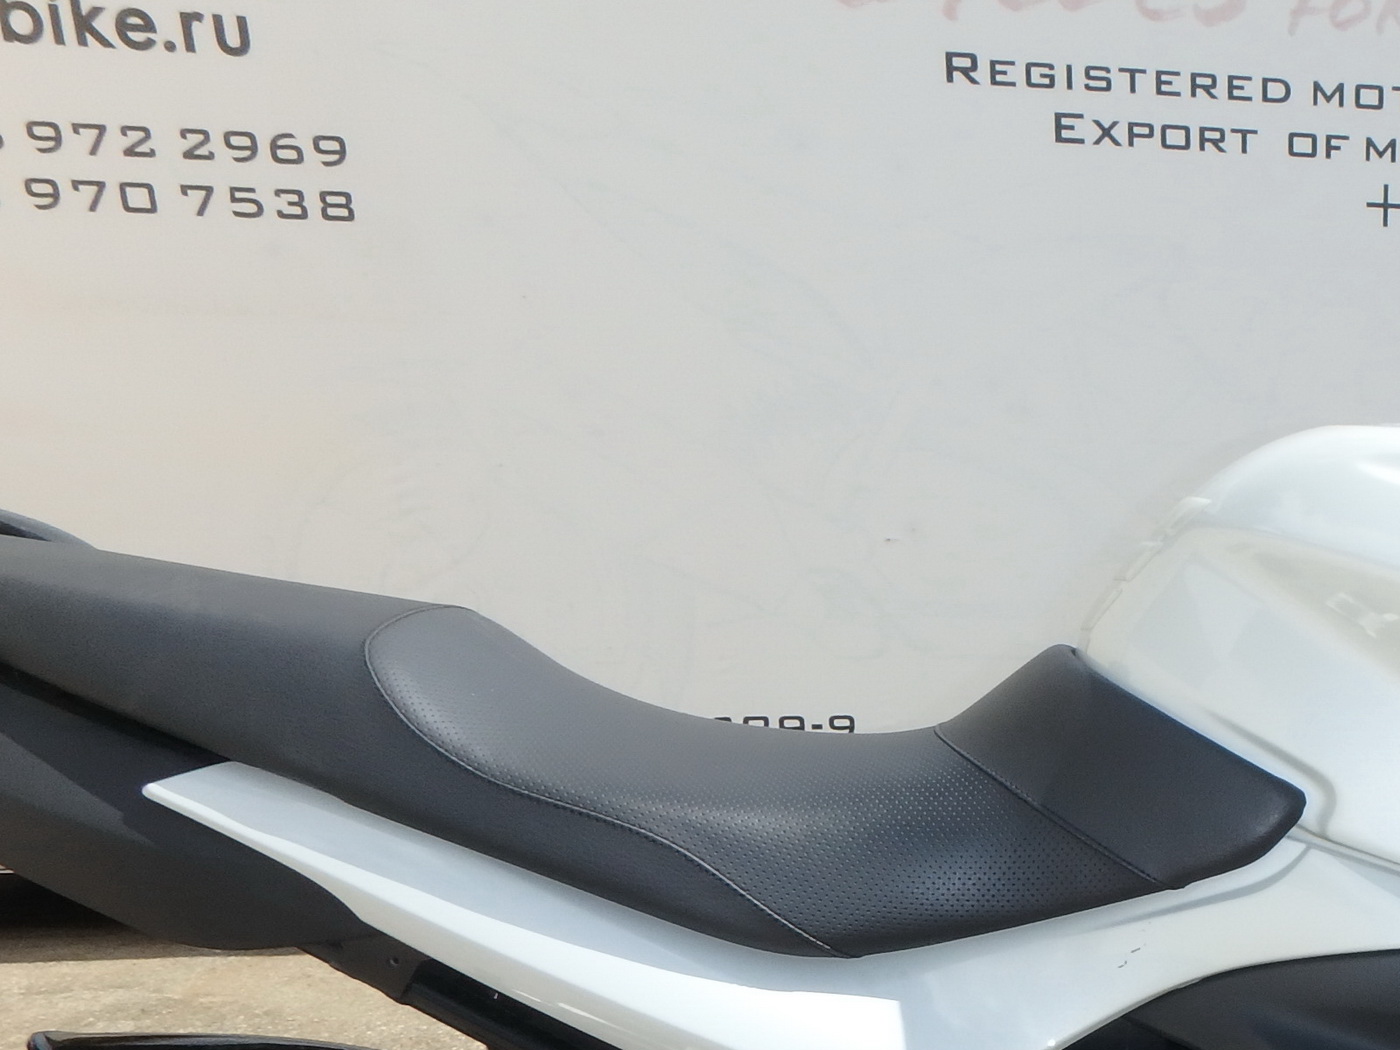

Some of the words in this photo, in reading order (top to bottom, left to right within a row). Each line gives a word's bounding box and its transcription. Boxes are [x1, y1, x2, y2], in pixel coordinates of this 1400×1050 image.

[946, 52, 1290, 104] REGISTERED
[26, 121, 156, 158] 972
[180, 128, 347, 167] 2969
[1055, 112, 1258, 154] EXPORT
[1288, 133, 1350, 160] OF
[24, 178, 157, 214] 970
[180, 184, 355, 222] 7538
